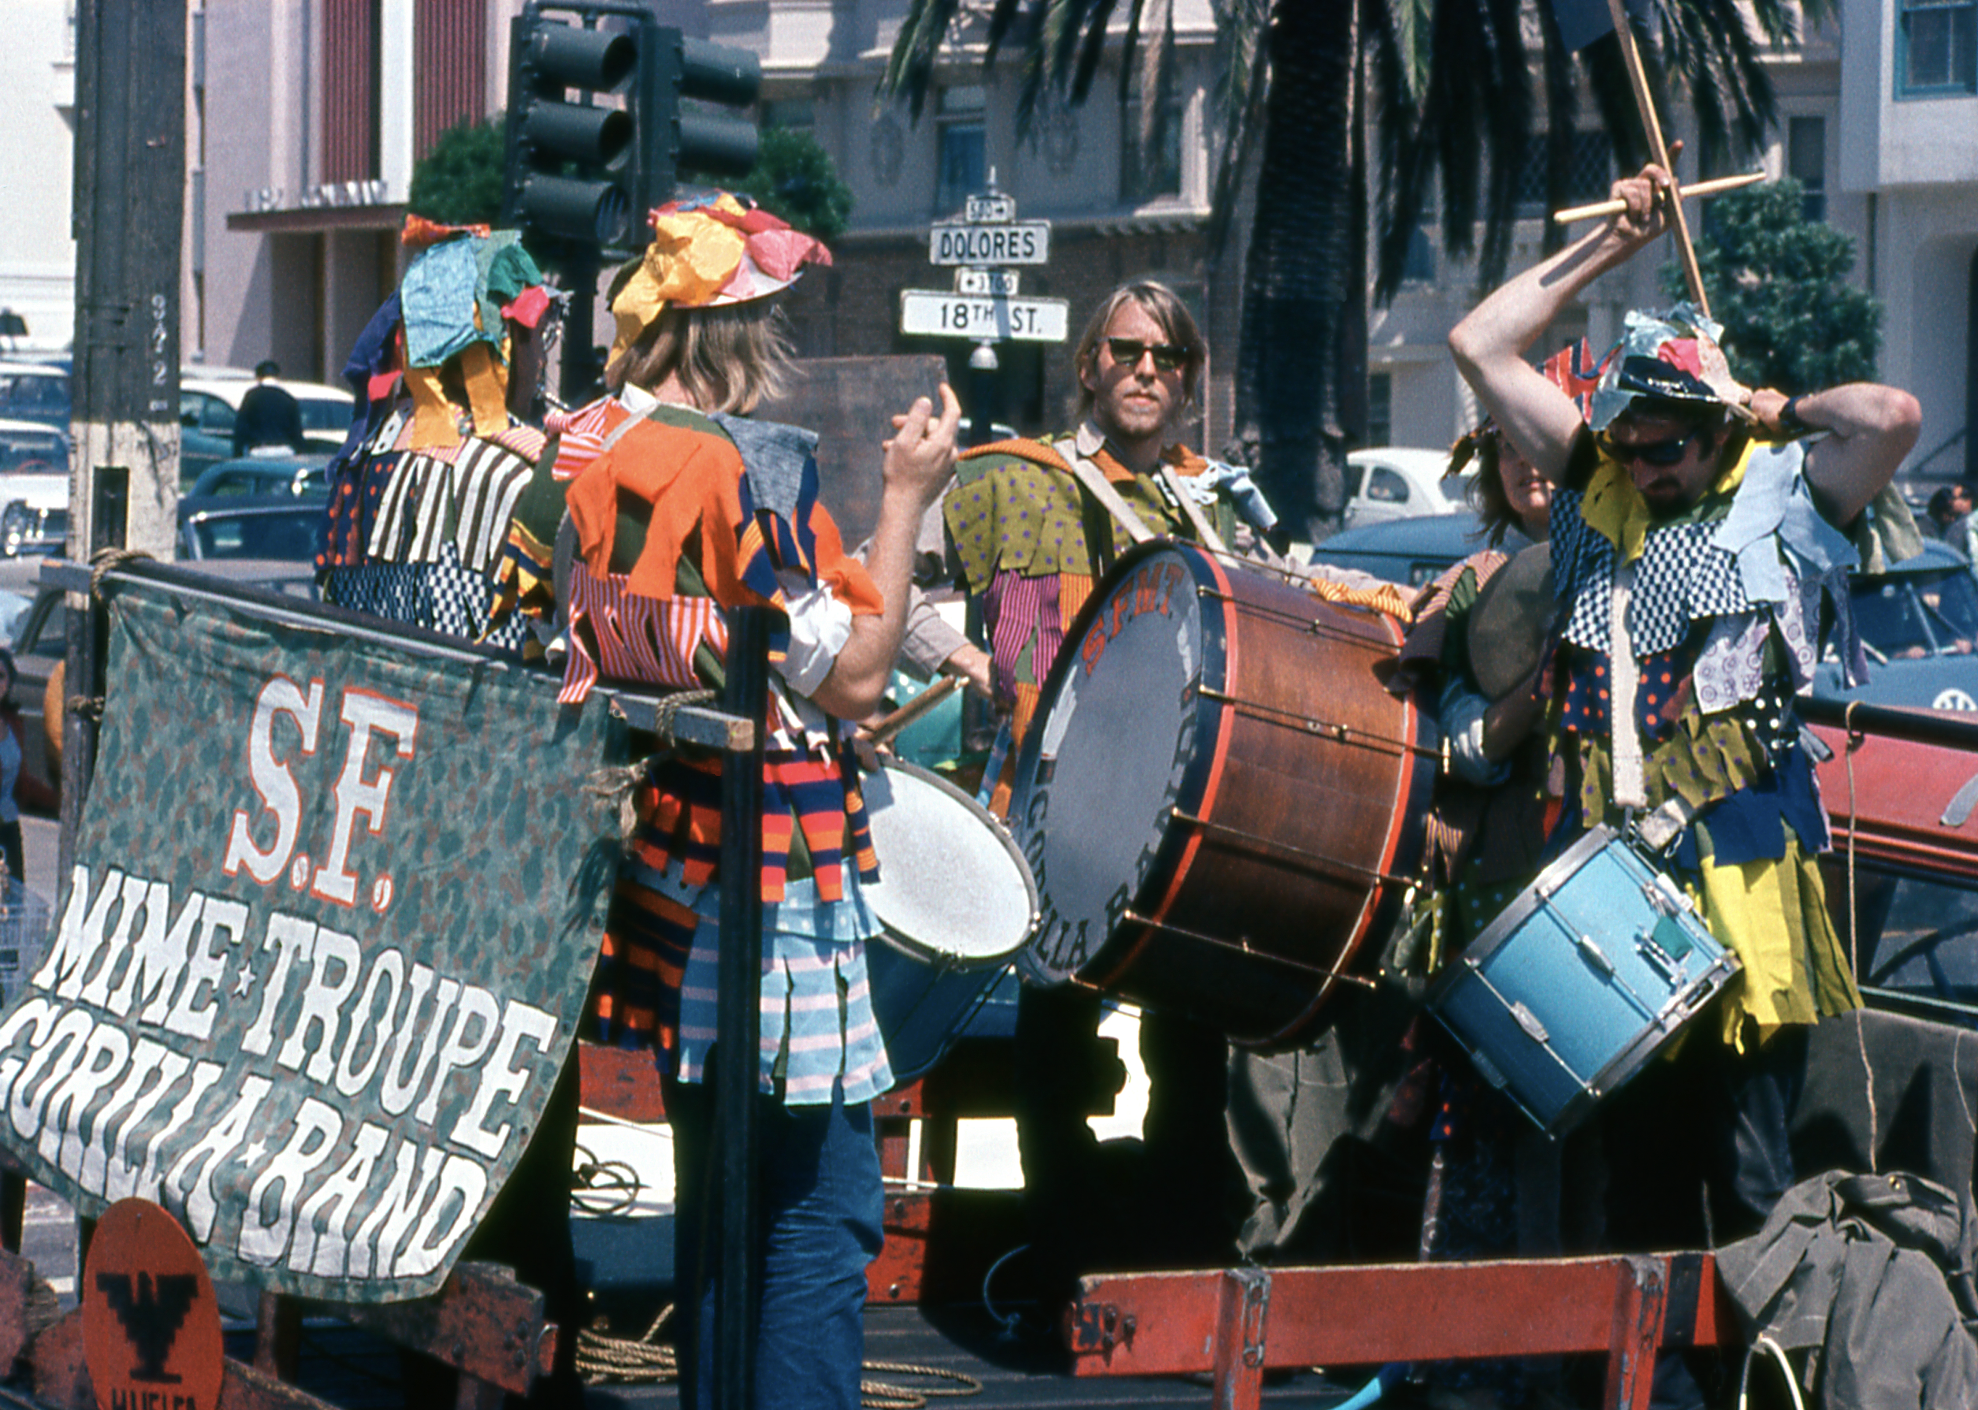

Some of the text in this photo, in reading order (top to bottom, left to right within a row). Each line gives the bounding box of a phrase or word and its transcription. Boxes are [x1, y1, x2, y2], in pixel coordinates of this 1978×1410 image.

[941, 232, 1035, 259] DOLORES
[941, 304, 1042, 334] 18TH ST.
[225, 675, 417, 911] S.F.
[34, 866, 558, 1159] MIME TROUPE
[0, 997, 488, 1278] GORILLA BAND
